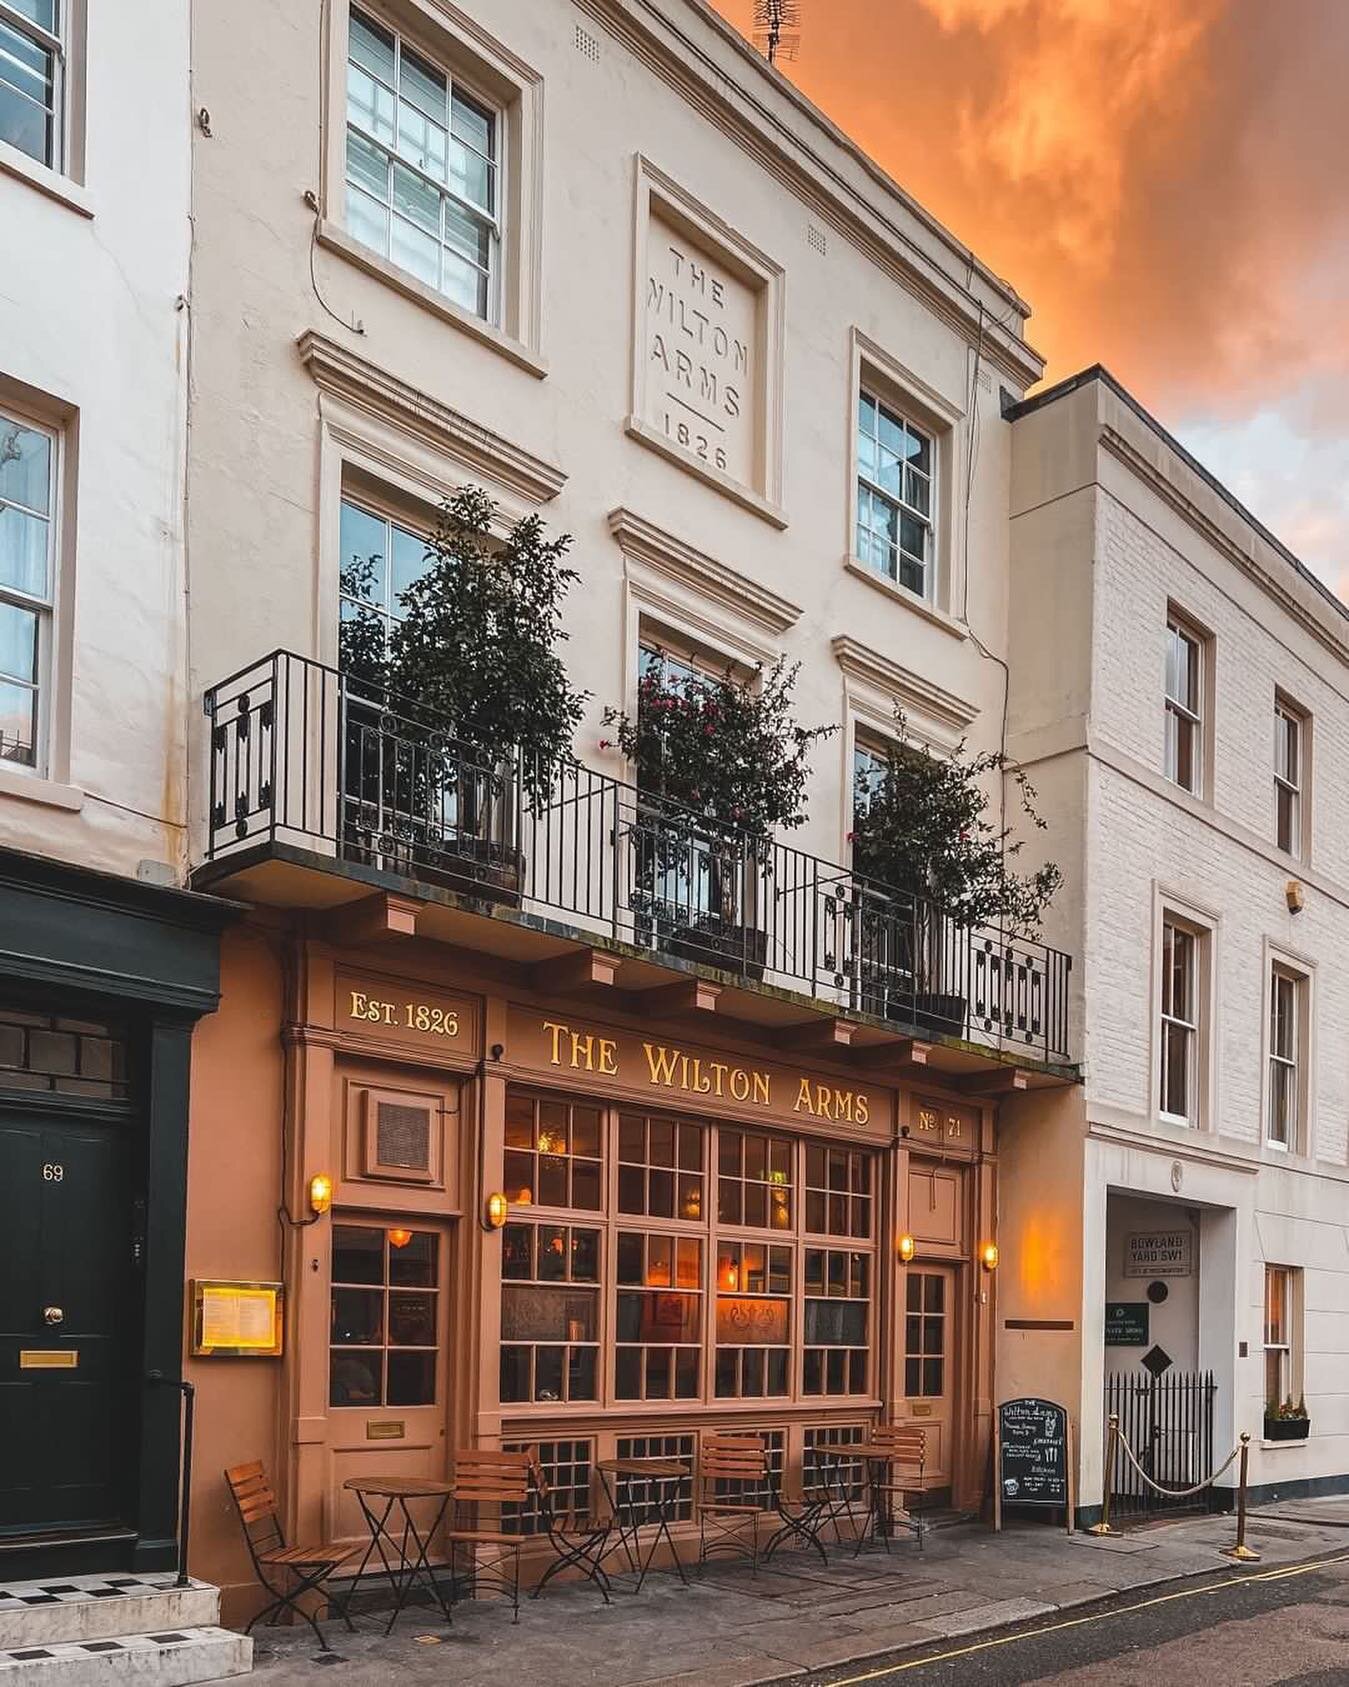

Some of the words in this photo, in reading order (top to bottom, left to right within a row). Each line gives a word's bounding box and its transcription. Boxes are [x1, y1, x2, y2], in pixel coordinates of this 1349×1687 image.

[669, 247, 724, 309] THE
[648, 277, 748, 377] WILTON
[651, 334, 740, 418] ARMS
[665, 413, 728, 470] 1826
[405, 1003, 459, 1036] 1826
[543, 1020, 619, 1076] THE
[643, 1042, 771, 1105] WILTON
[794, 1078, 870, 1126] ARMS
[948, 1117, 961, 1137] 71
[43, 1163, 64, 1182] 69
